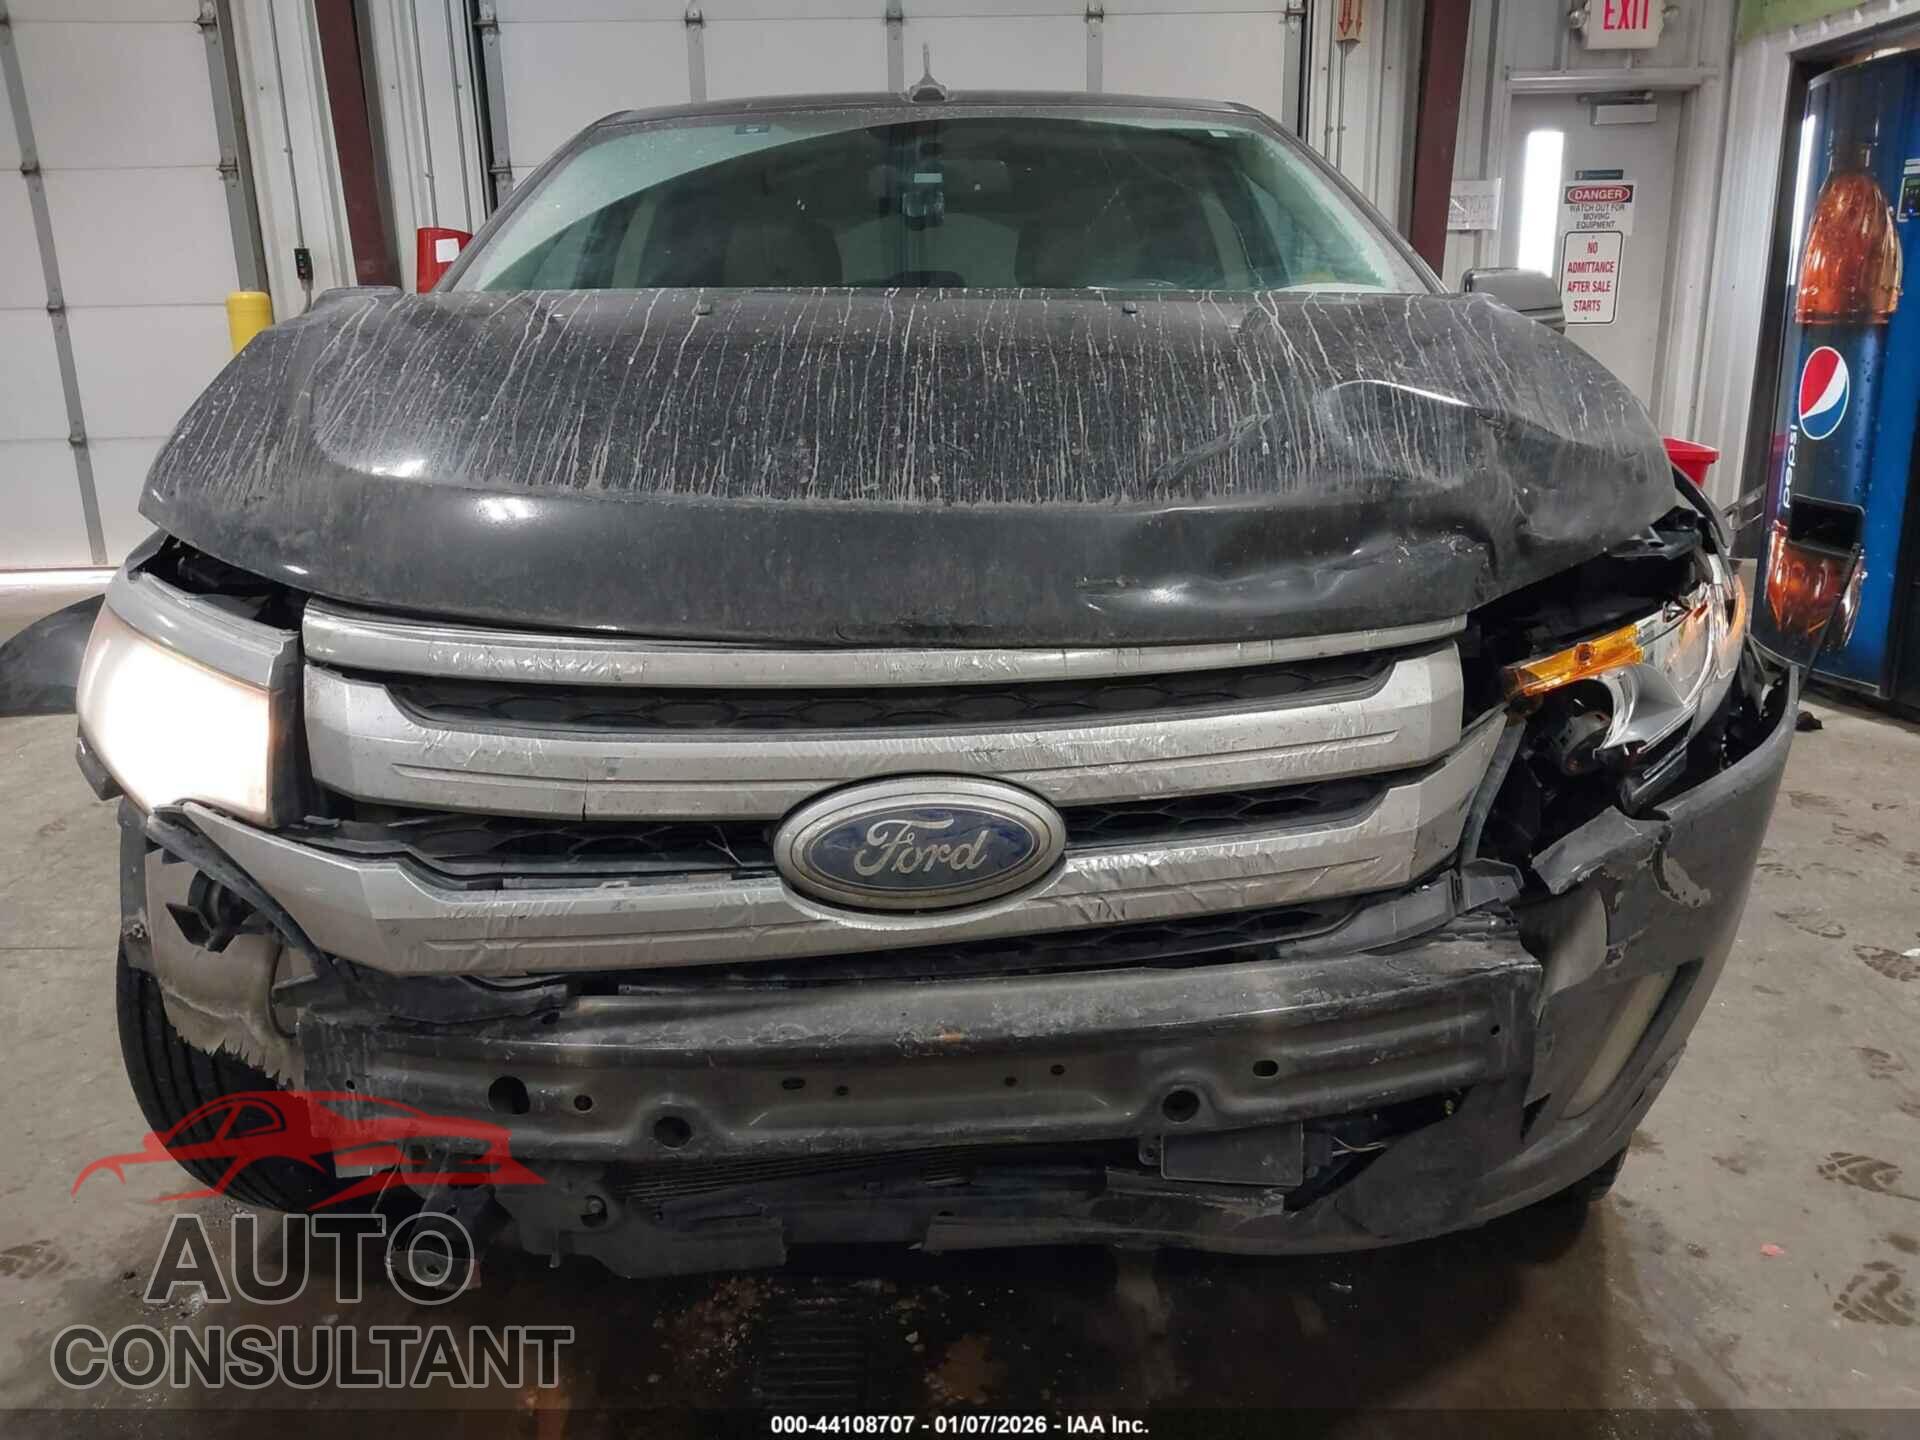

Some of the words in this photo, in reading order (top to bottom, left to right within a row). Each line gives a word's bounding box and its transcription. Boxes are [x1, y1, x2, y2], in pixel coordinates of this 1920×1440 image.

[1603, 0, 1649, 30] EXIT
[1574, 189, 1623, 200] DANGER
[1595, 204, 1609, 212] OUT
[1610, 203, 1625, 212] FOR
[1576, 220, 1616, 229] EQUIPMENT
[1587, 241, 1598, 254] NO
[1567, 261, 1615, 273] ADMITTANCE
[1567, 281, 1591, 293] AFTER
[1592, 281, 1611, 292] SALE
[1573, 300, 1601, 312] STARTS
[1783, 424, 1798, 508] pepsi
[853, 818, 990, 876] Ford
